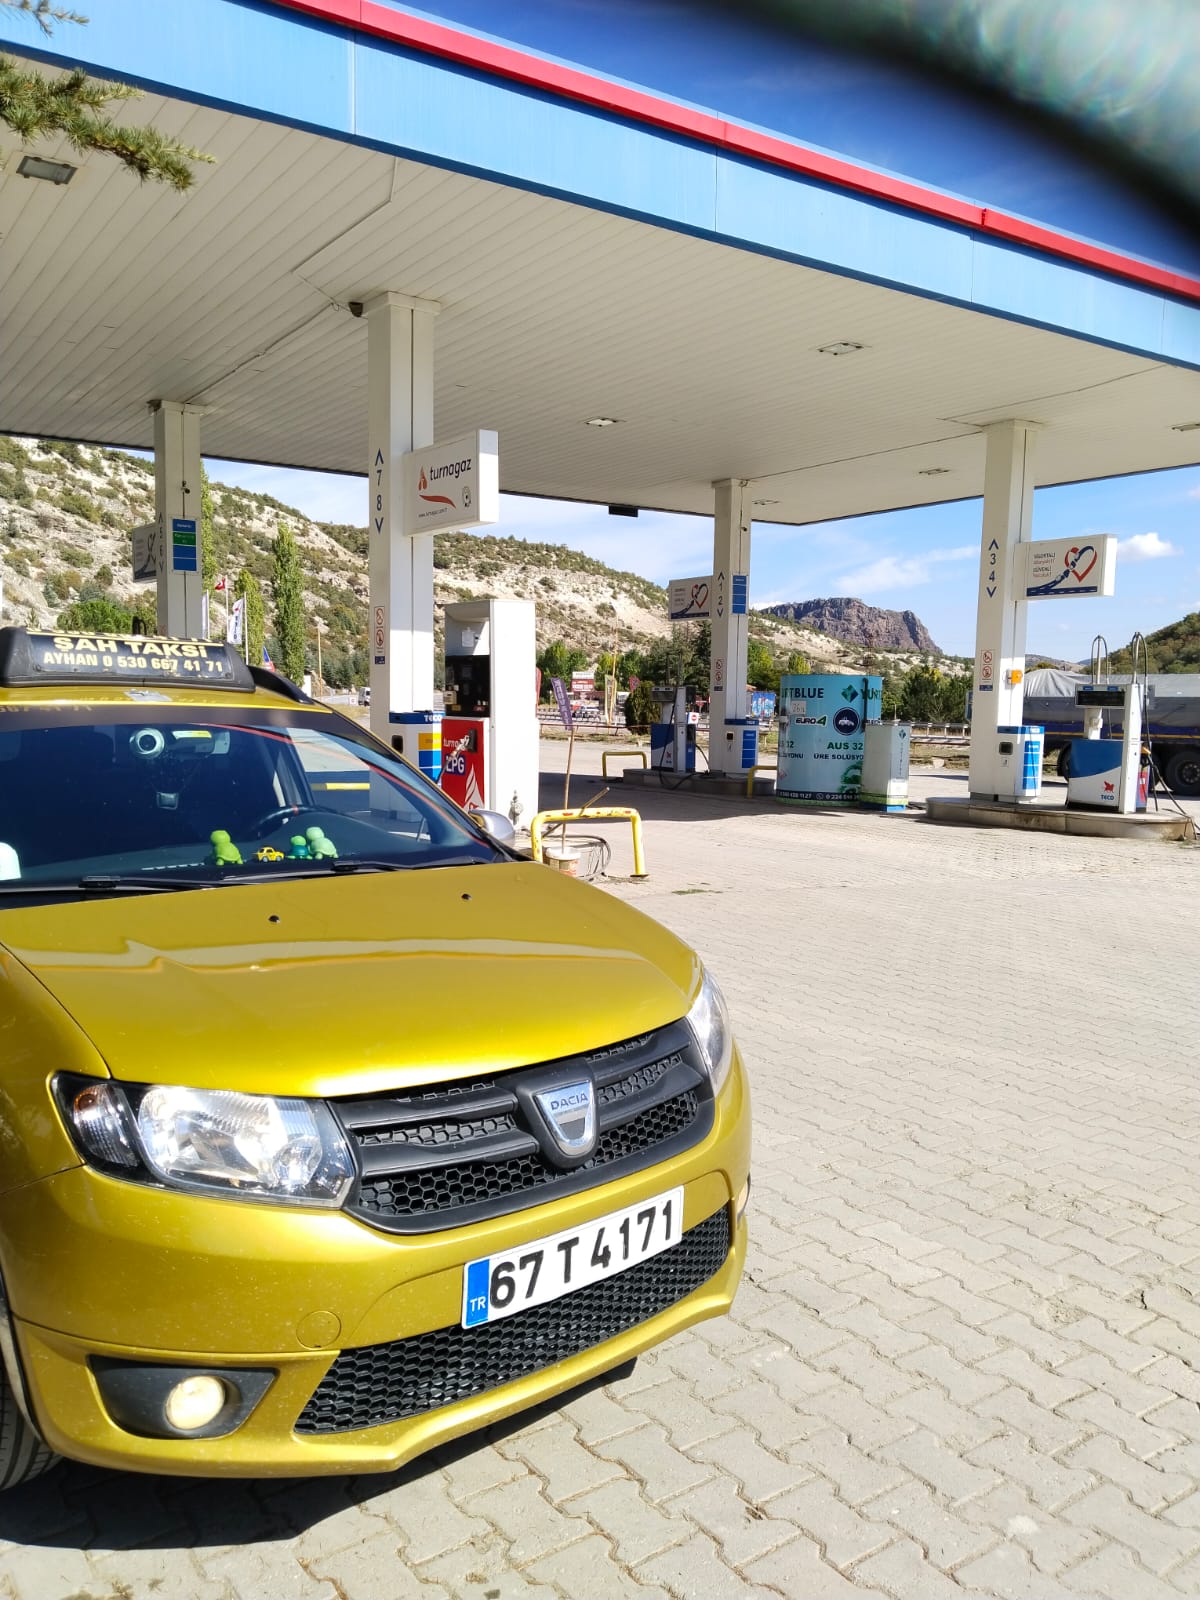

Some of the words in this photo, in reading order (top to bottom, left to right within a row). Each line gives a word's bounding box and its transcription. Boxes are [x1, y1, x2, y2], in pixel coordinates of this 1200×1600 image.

[376, 469, 383, 486] 7
[430, 458, 472, 480] turnagaz
[376, 494, 383, 511] 8
[990, 553, 996, 565] 3
[989, 570, 996, 582] 4
[718, 596, 723, 605] 2
[53, 637, 118, 653] ŞAH
[43, 652, 98, 666] AYHAN
[102, 655, 113, 667] 0
[117, 656, 147, 669] 530
[151, 658, 178, 671] 667
[183, 659, 201, 671] 41
[205, 660, 223, 672] 71
[827, 742, 849, 750] AUS
[852, 742, 864, 750] 32
[446, 756, 465, 773] LPG
[831, 752, 864, 760] SOLÜSYO
[550, 1093, 588, 1111] DACIA
[470, 1296, 486, 1312] TR
[489, 1250, 544, 1310] 67
[557, 1236, 580, 1284] T
[590, 1200, 672, 1269] 4171
